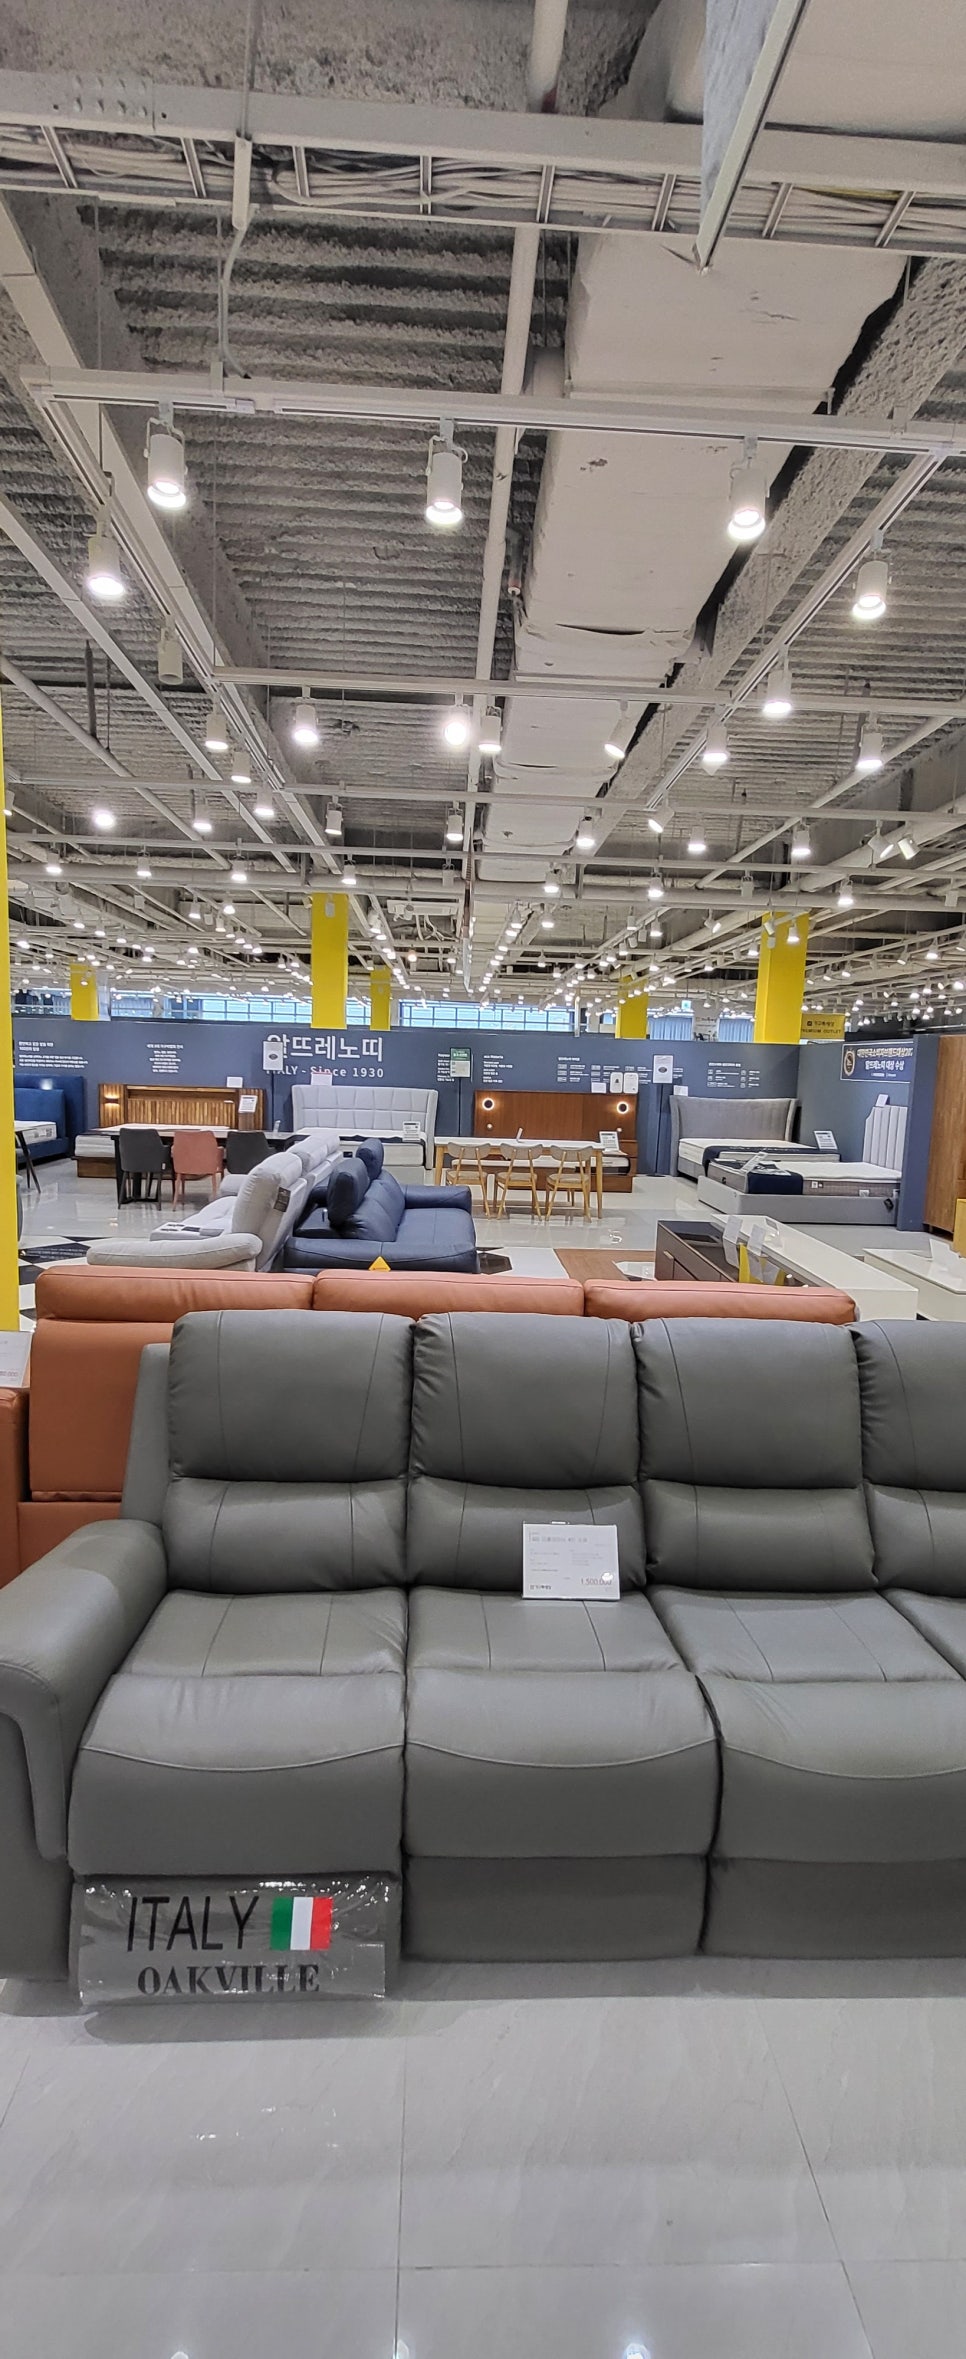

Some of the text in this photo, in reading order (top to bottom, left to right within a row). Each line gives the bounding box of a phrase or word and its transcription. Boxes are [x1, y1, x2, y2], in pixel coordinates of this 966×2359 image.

[352, 1067, 384, 1078] 1930
[127, 1895, 260, 1952] ITALY
[137, 1963, 320, 1996] OAKVILLE
